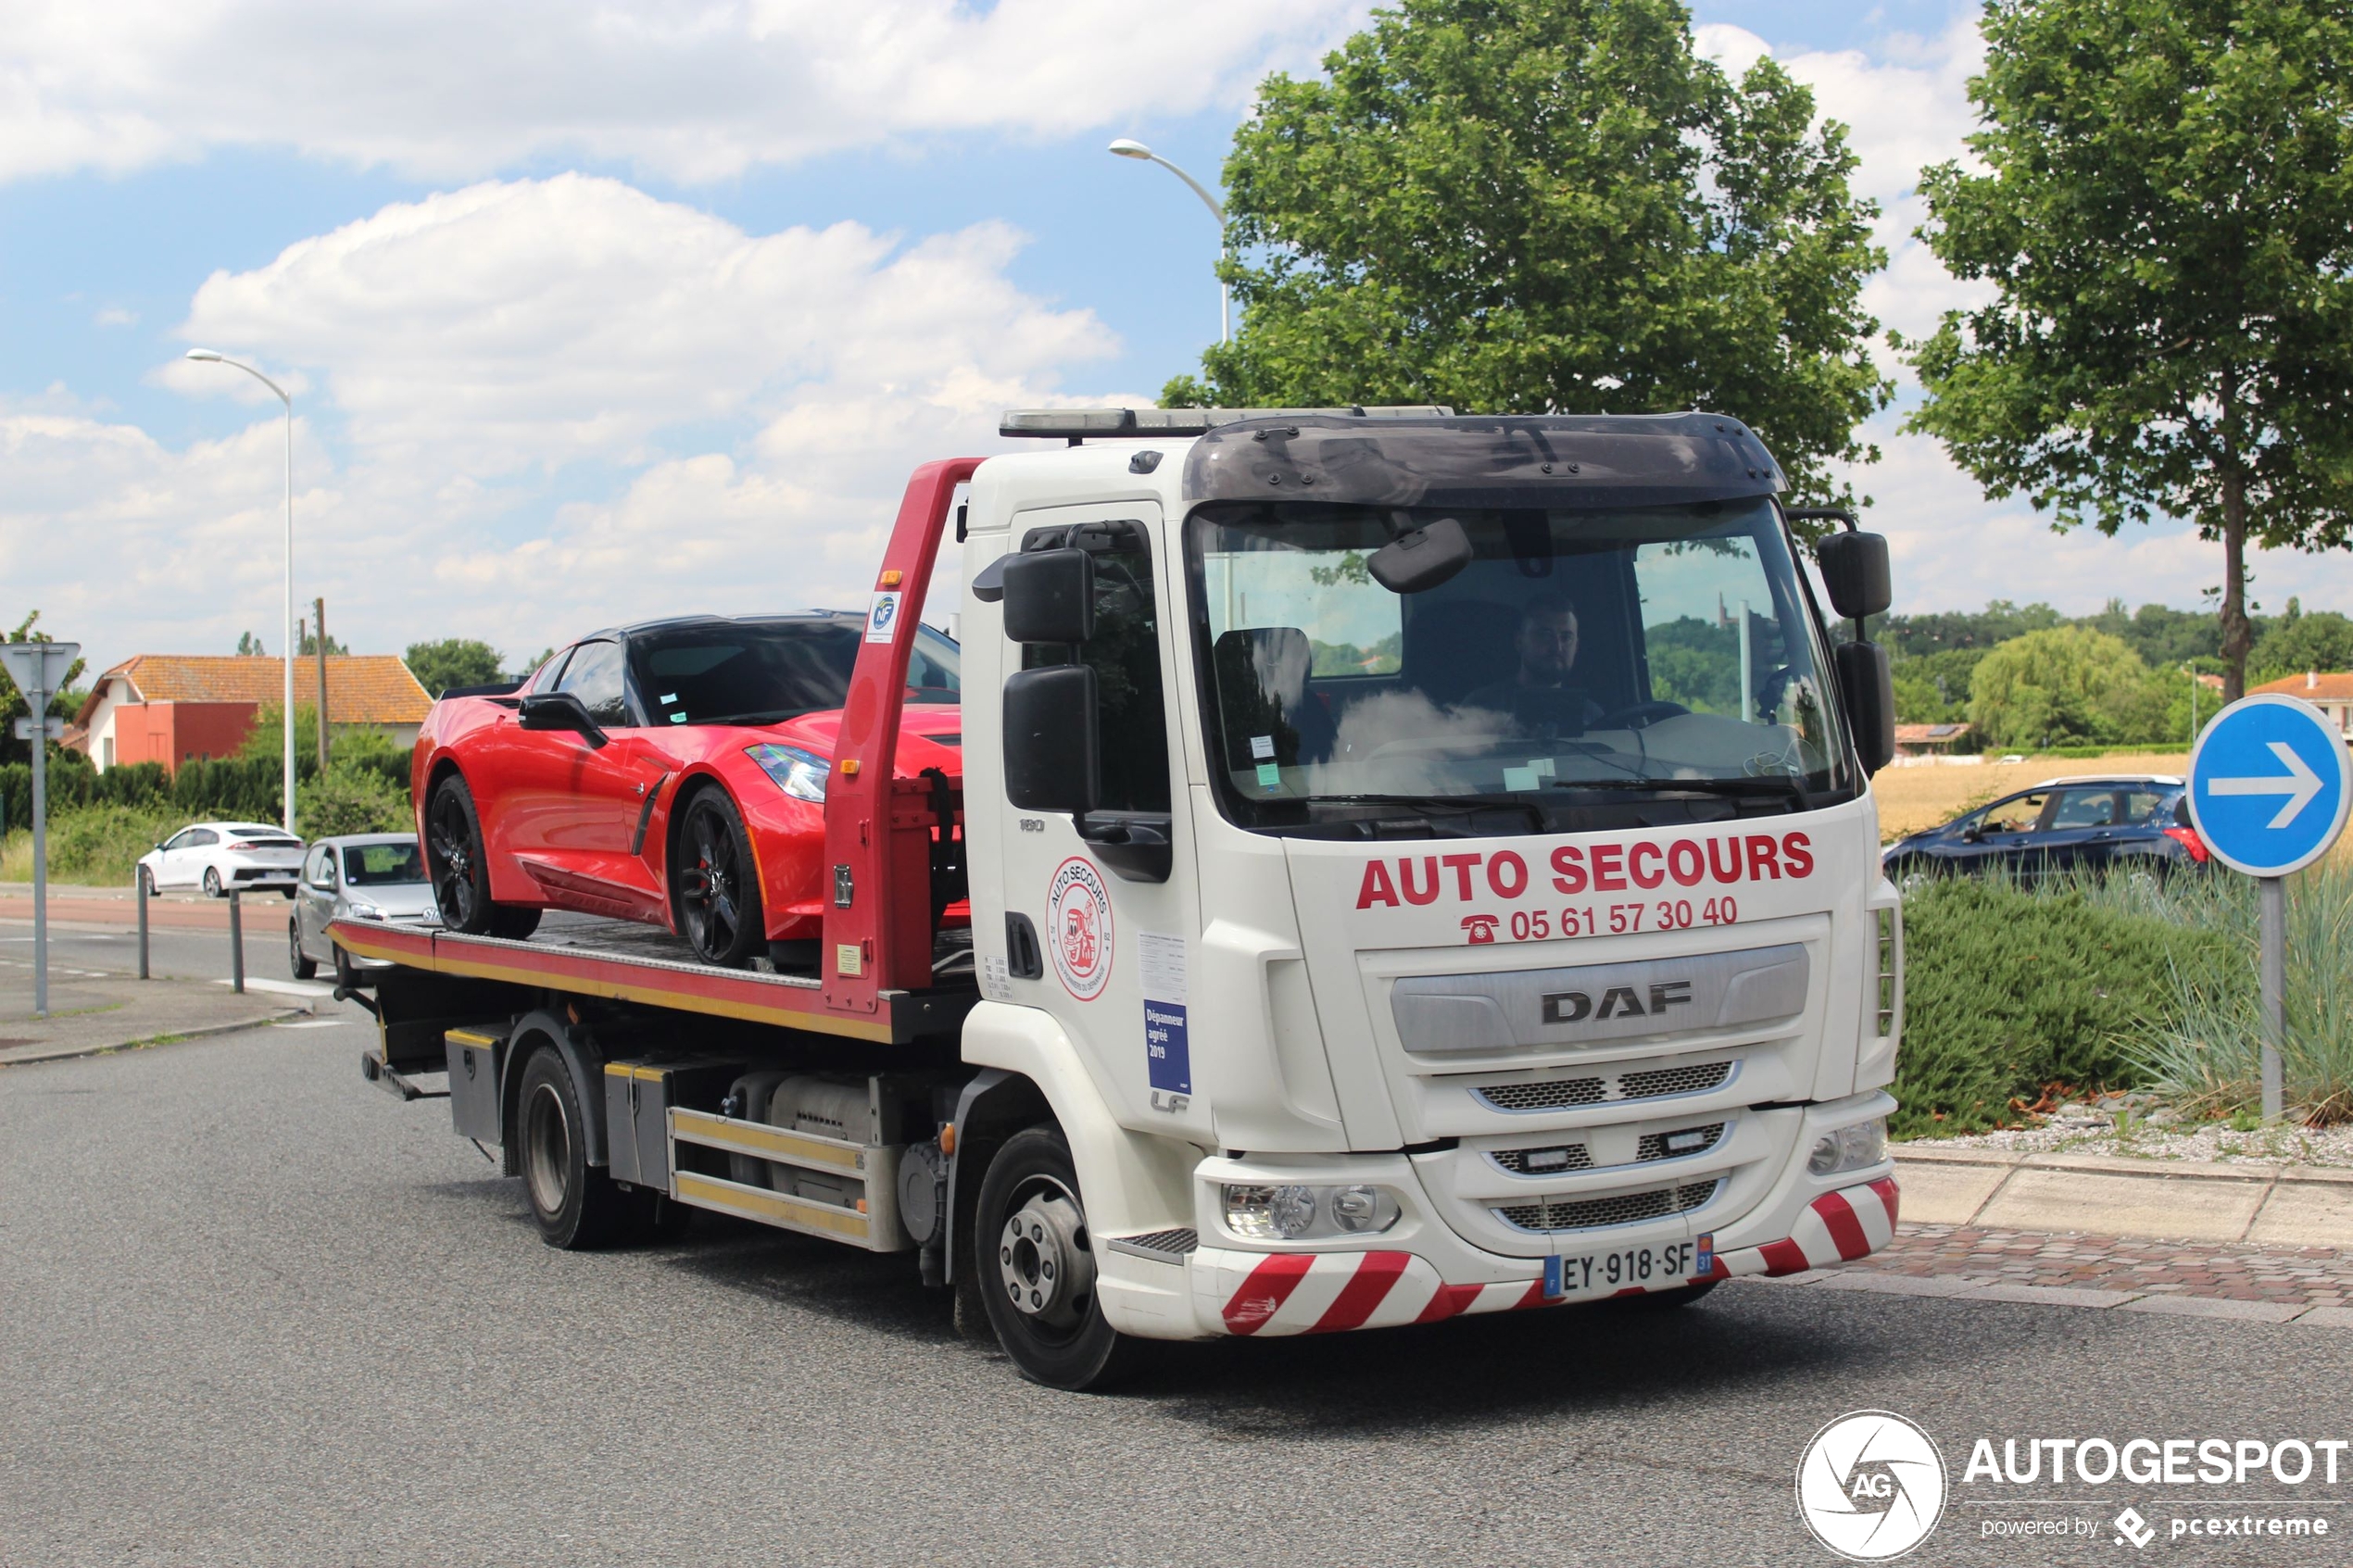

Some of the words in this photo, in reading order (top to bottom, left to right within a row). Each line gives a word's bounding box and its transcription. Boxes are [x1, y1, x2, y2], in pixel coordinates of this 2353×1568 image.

[876, 606, 892, 621] NF
[1356, 850, 1529, 909] AUTO
[1551, 832, 1815, 895] SECOURS
[1051, 871, 1070, 910] AUTO
[1070, 866, 1108, 914] SECOURS
[1512, 910, 1550, 941] 05
[1562, 907, 1595, 936] 61
[1611, 903, 1644, 934] 57
[1657, 900, 1692, 930] 30
[1704, 897, 1738, 925] 40
[1146, 1008, 1184, 1027] Dépanneur
[1541, 980, 1693, 1024] DAF
[1148, 1028, 1168, 1043] agréé
[1149, 1044, 1165, 1060] 2019
[1151, 1090, 1189, 1114] LF
[1564, 1243, 1693, 1291] EY-918-SF
[1698, 1254, 1711, 1271] 31
